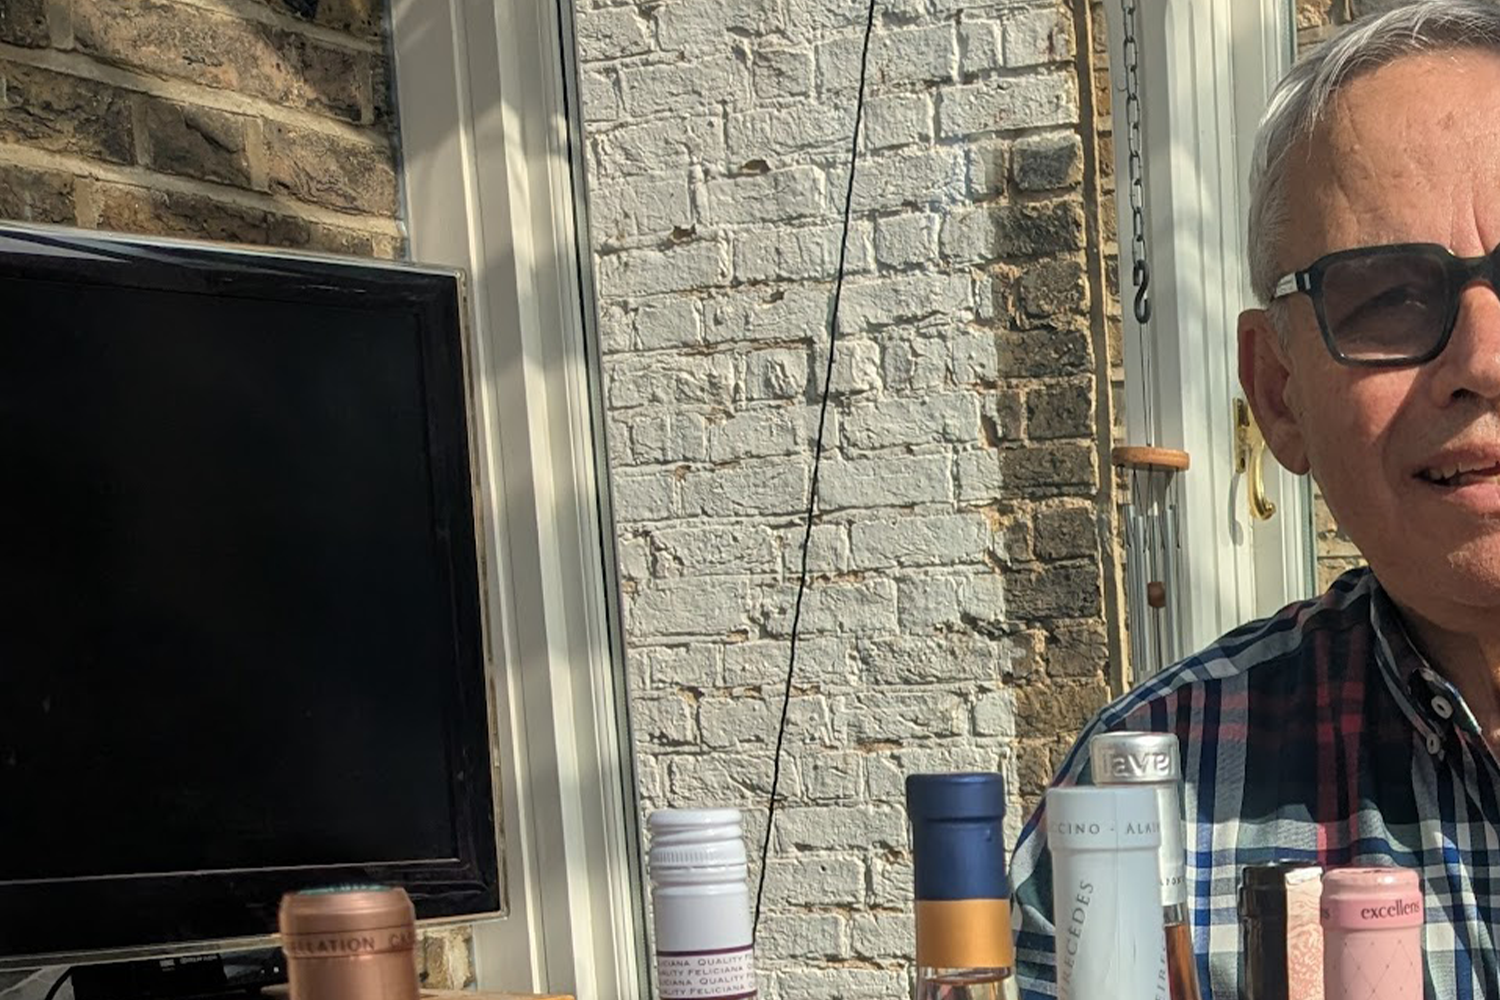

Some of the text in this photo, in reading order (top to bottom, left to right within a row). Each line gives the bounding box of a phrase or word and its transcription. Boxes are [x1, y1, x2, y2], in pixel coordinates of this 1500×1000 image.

[1361, 900, 1420, 920] excellens
[697, 956, 743, 966] QUALITY
[688, 966, 743, 976] FELICIANA
[699, 974, 744, 985] QUALITY
[690, 984, 744, 995] FELICIANA
